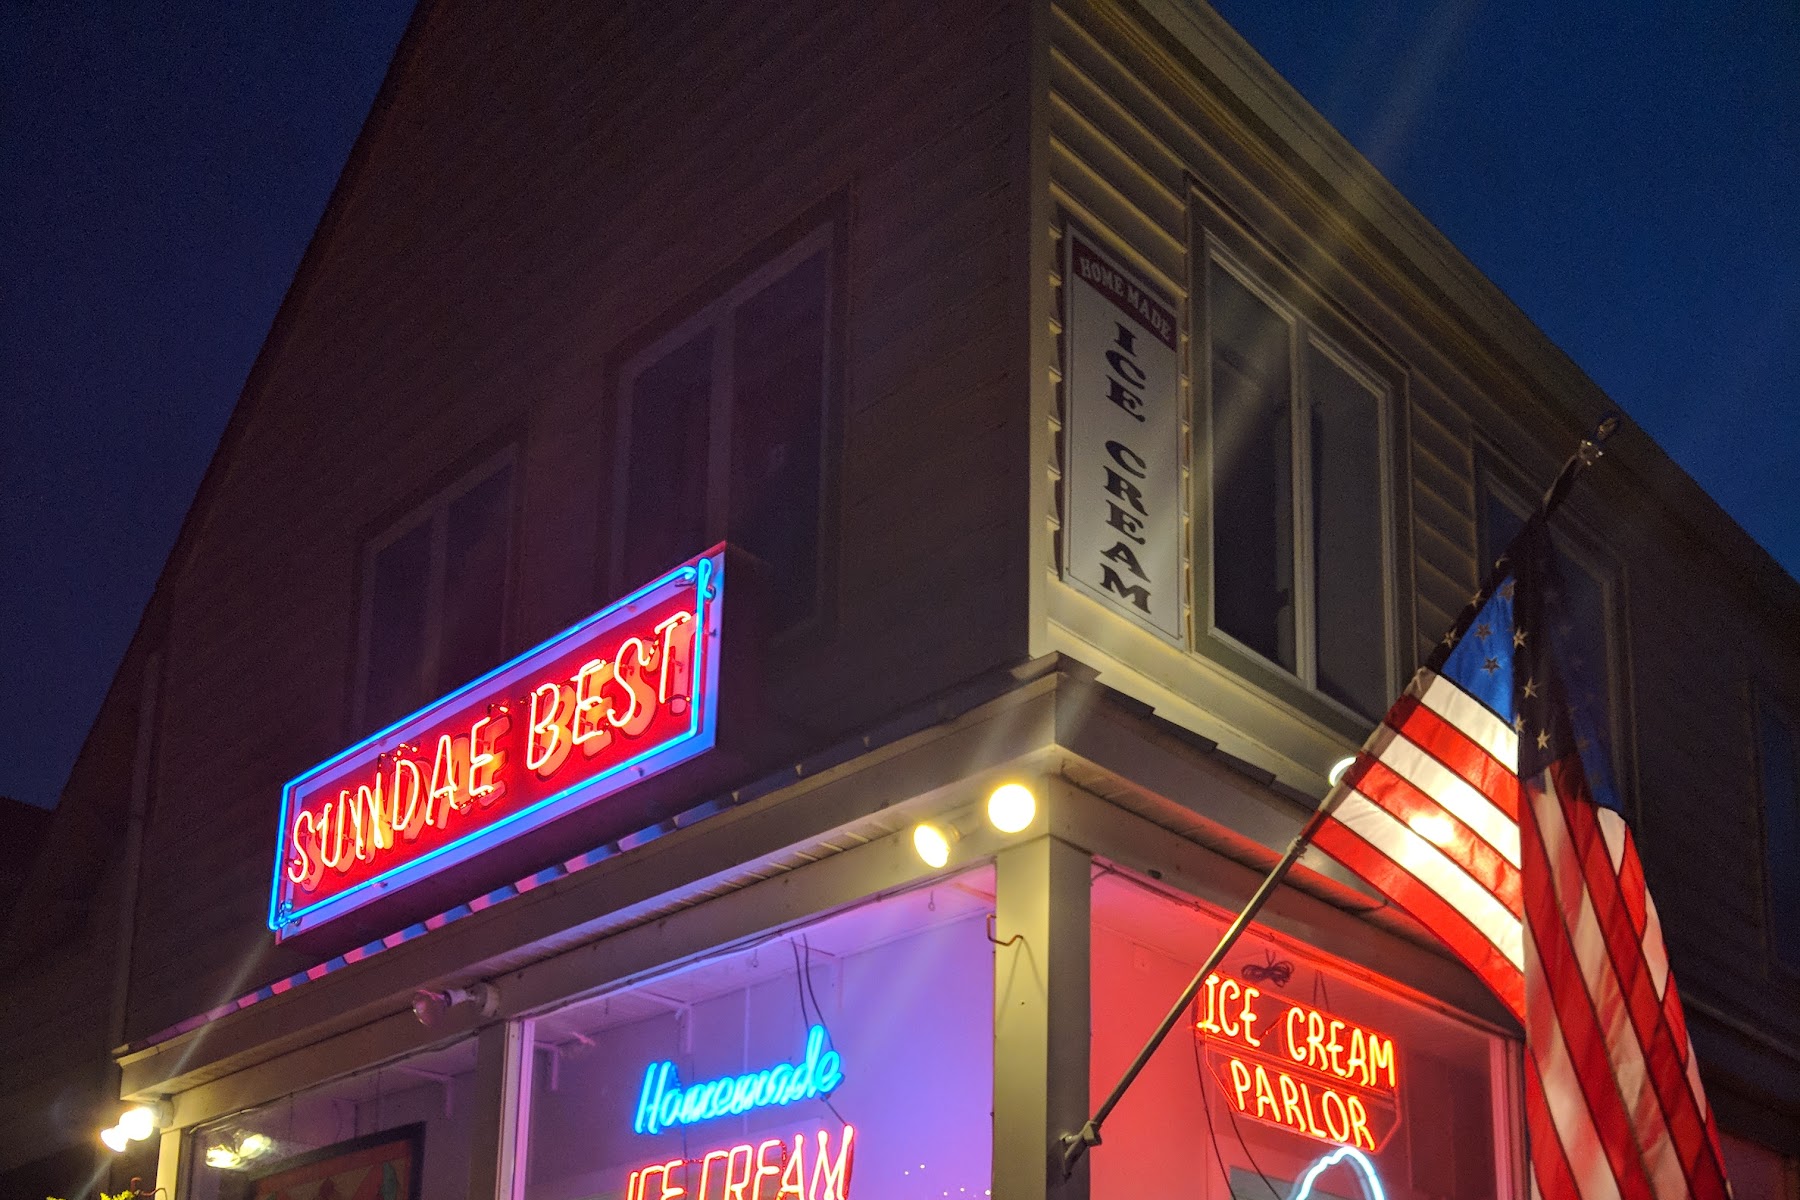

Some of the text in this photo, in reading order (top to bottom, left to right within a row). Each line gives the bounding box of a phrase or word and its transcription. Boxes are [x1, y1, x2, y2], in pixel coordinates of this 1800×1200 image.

[1100, 321, 1153, 614] ICE CREAM
[287, 611, 696, 888] SUNDAE BEST
[633, 1024, 844, 1135] Homemade
[1197, 973, 1397, 1088] ICE CREAM
[1229, 1057, 1376, 1152] PARLOR
